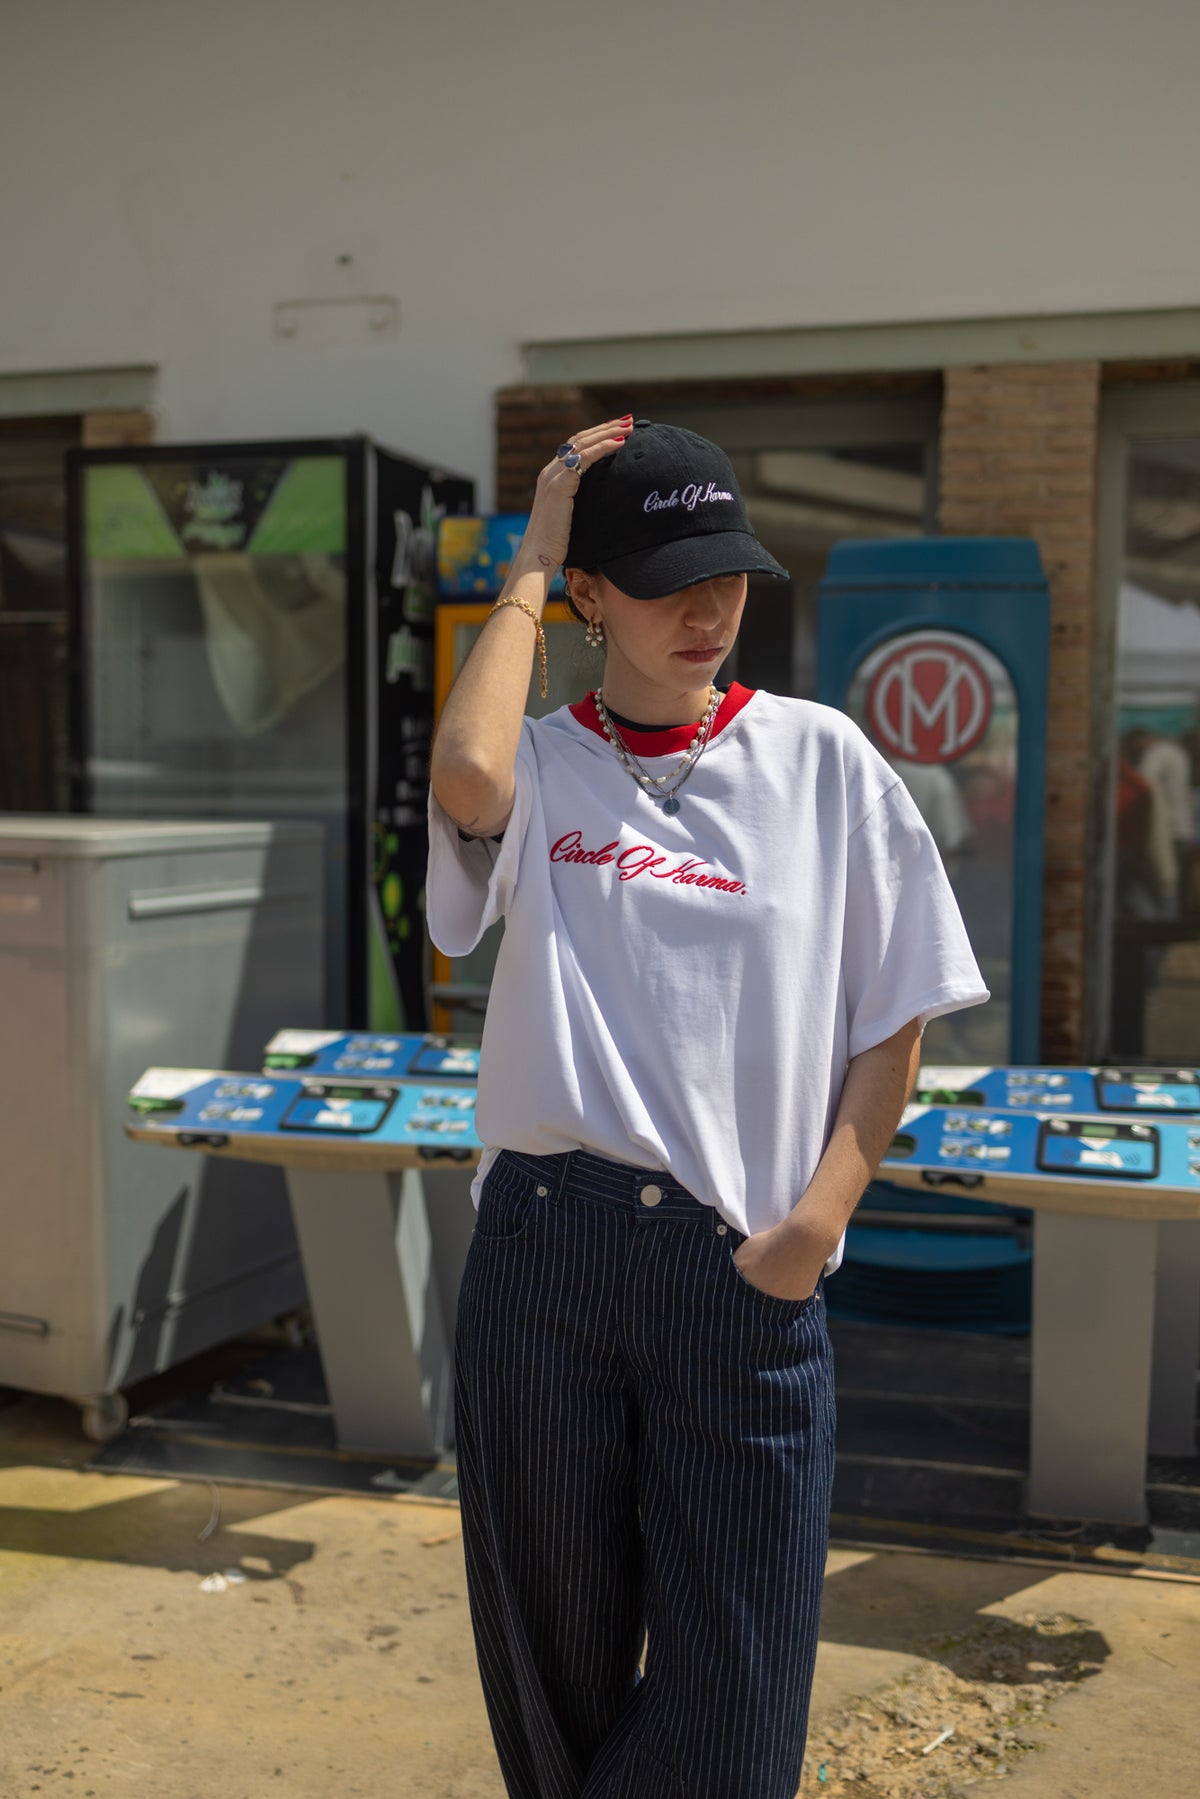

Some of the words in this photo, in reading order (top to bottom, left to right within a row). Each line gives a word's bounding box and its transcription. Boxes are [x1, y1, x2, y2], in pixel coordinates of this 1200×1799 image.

[643, 489, 678, 512] Circle
[681, 484, 703, 511] Of
[699, 482, 734, 502] Karma.
[550, 831, 619, 865] Circle
[617, 845, 666, 880] Of
[650, 859, 747, 895] Karma.
